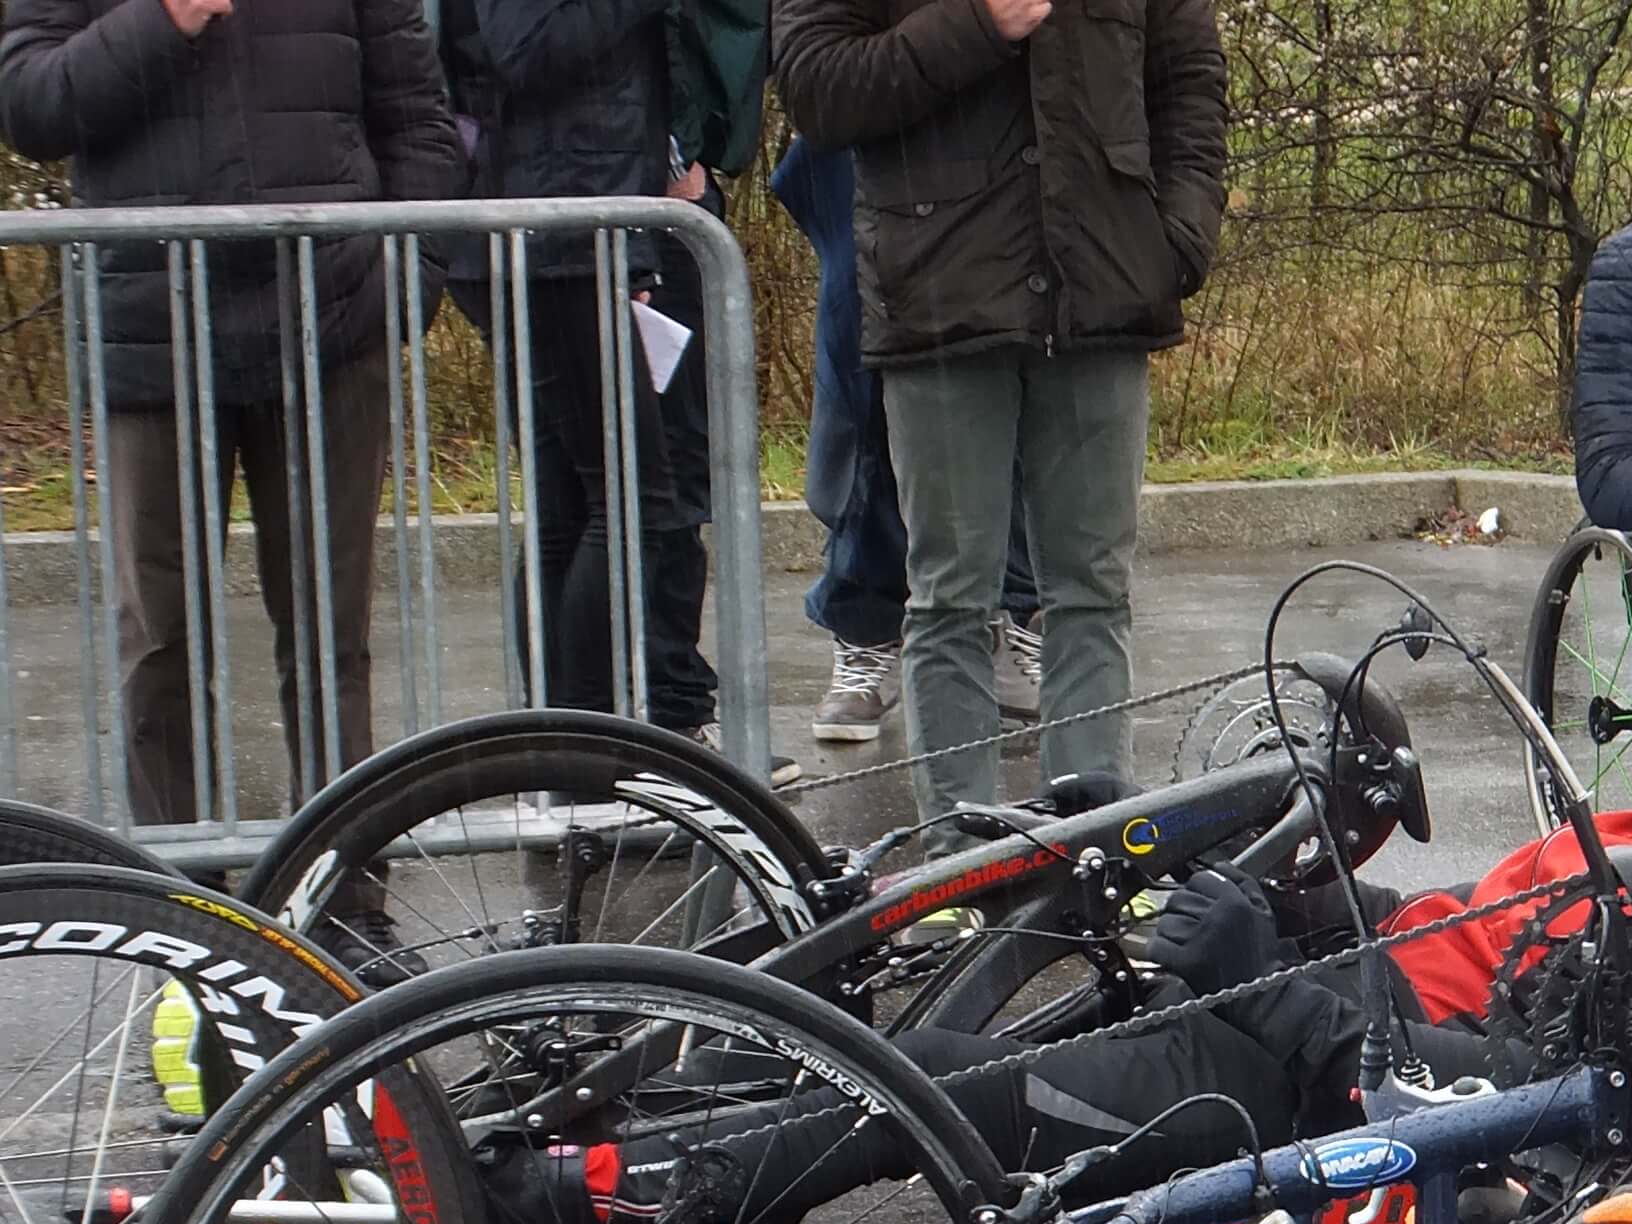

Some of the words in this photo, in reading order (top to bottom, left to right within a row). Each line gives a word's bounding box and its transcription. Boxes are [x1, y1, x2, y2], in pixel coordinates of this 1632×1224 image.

[870, 842, 1068, 933] carbonbike.ch
[0, 921, 325, 1041] CORIM
[776, 1038, 888, 1116] ALEXRIMS
